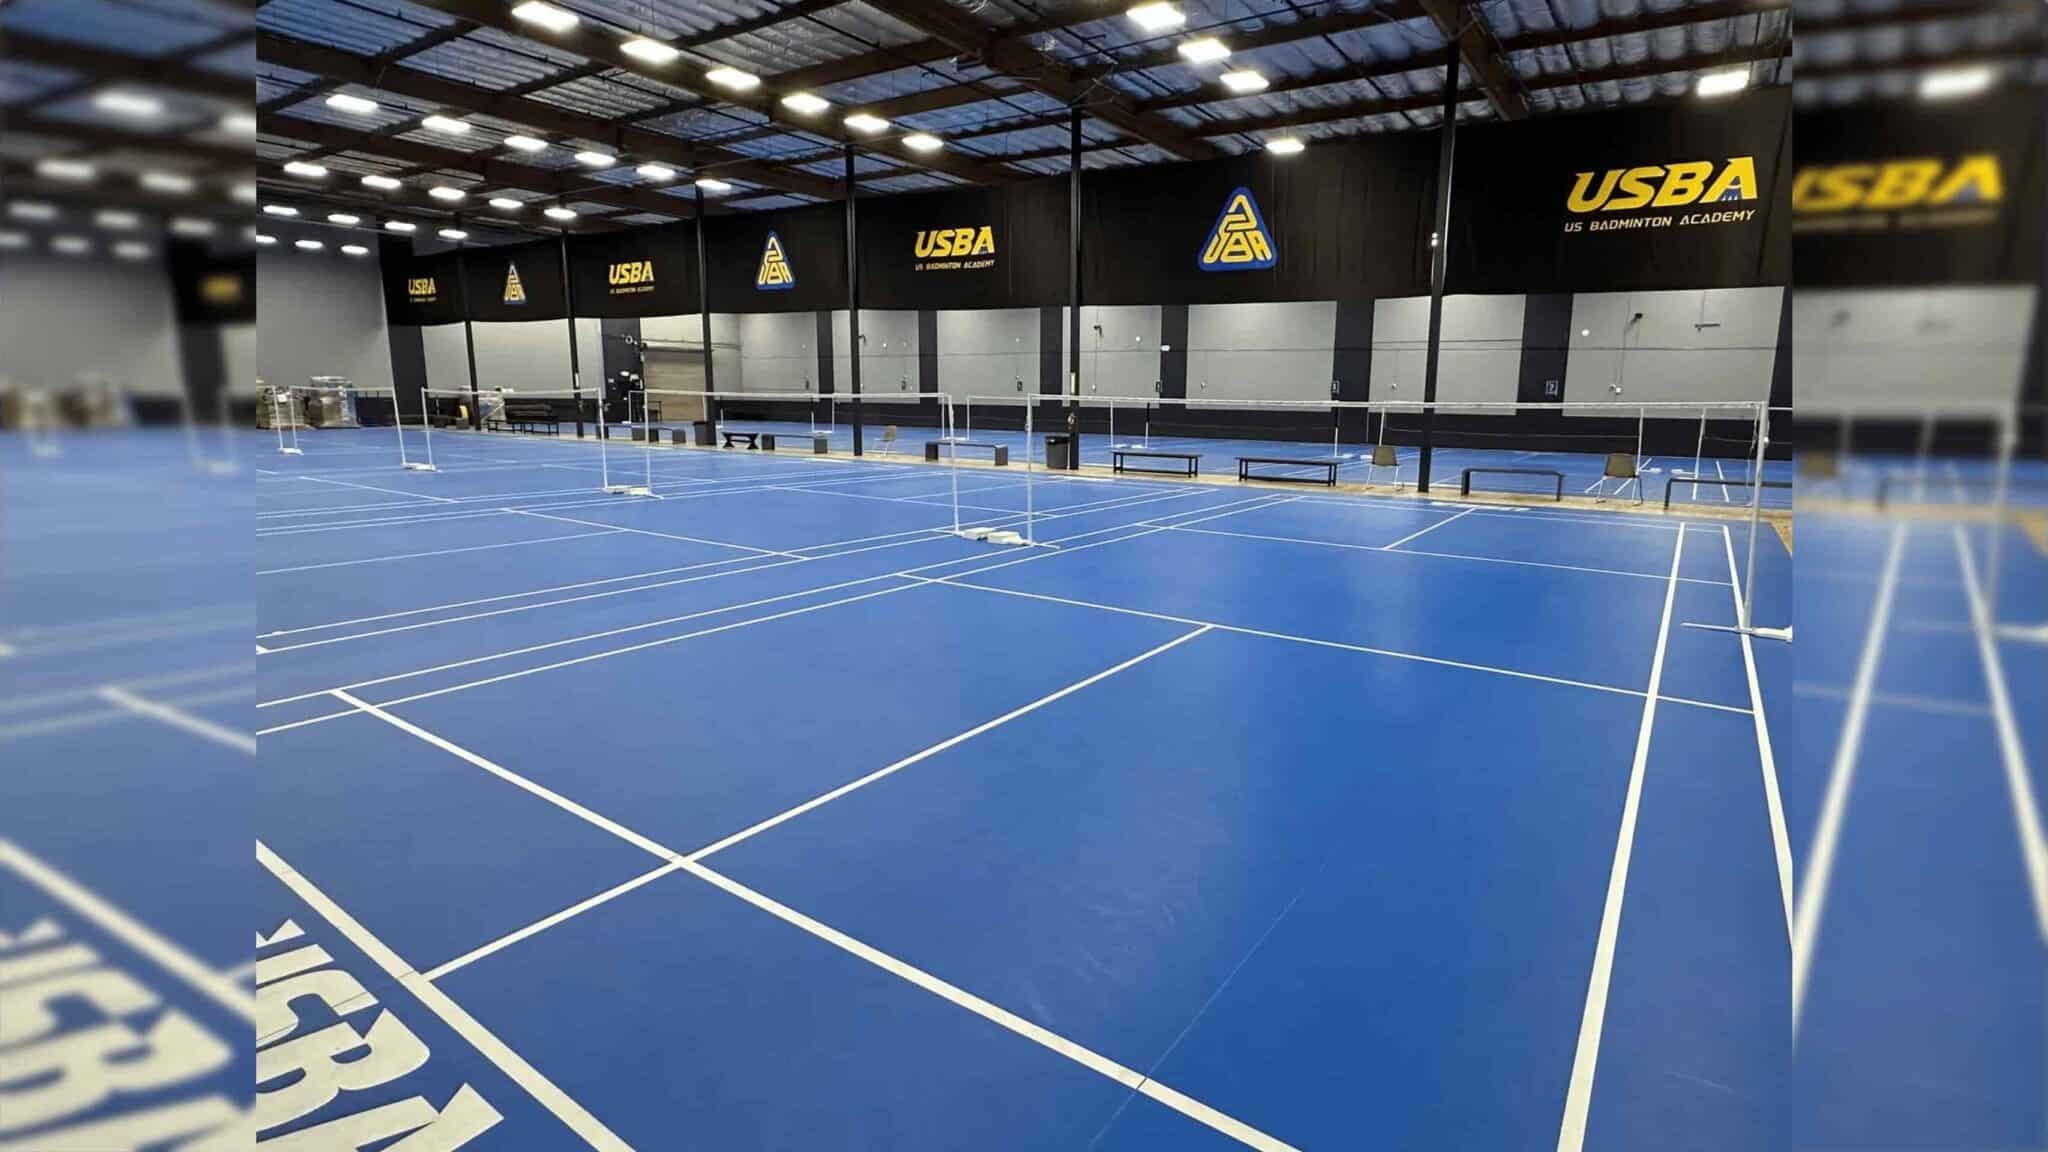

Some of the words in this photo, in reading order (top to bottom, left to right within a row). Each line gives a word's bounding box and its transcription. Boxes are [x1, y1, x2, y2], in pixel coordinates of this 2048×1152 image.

[1567, 157, 1758, 213] USBA
[1564, 222, 1583, 233] US
[1590, 216, 1673, 231] BADMINTON
[1680, 210, 1756, 225] ACADEMY
[915, 226, 995, 258] USBA
[609, 261, 655, 285] USBA
[408, 277, 437, 295] USBA
